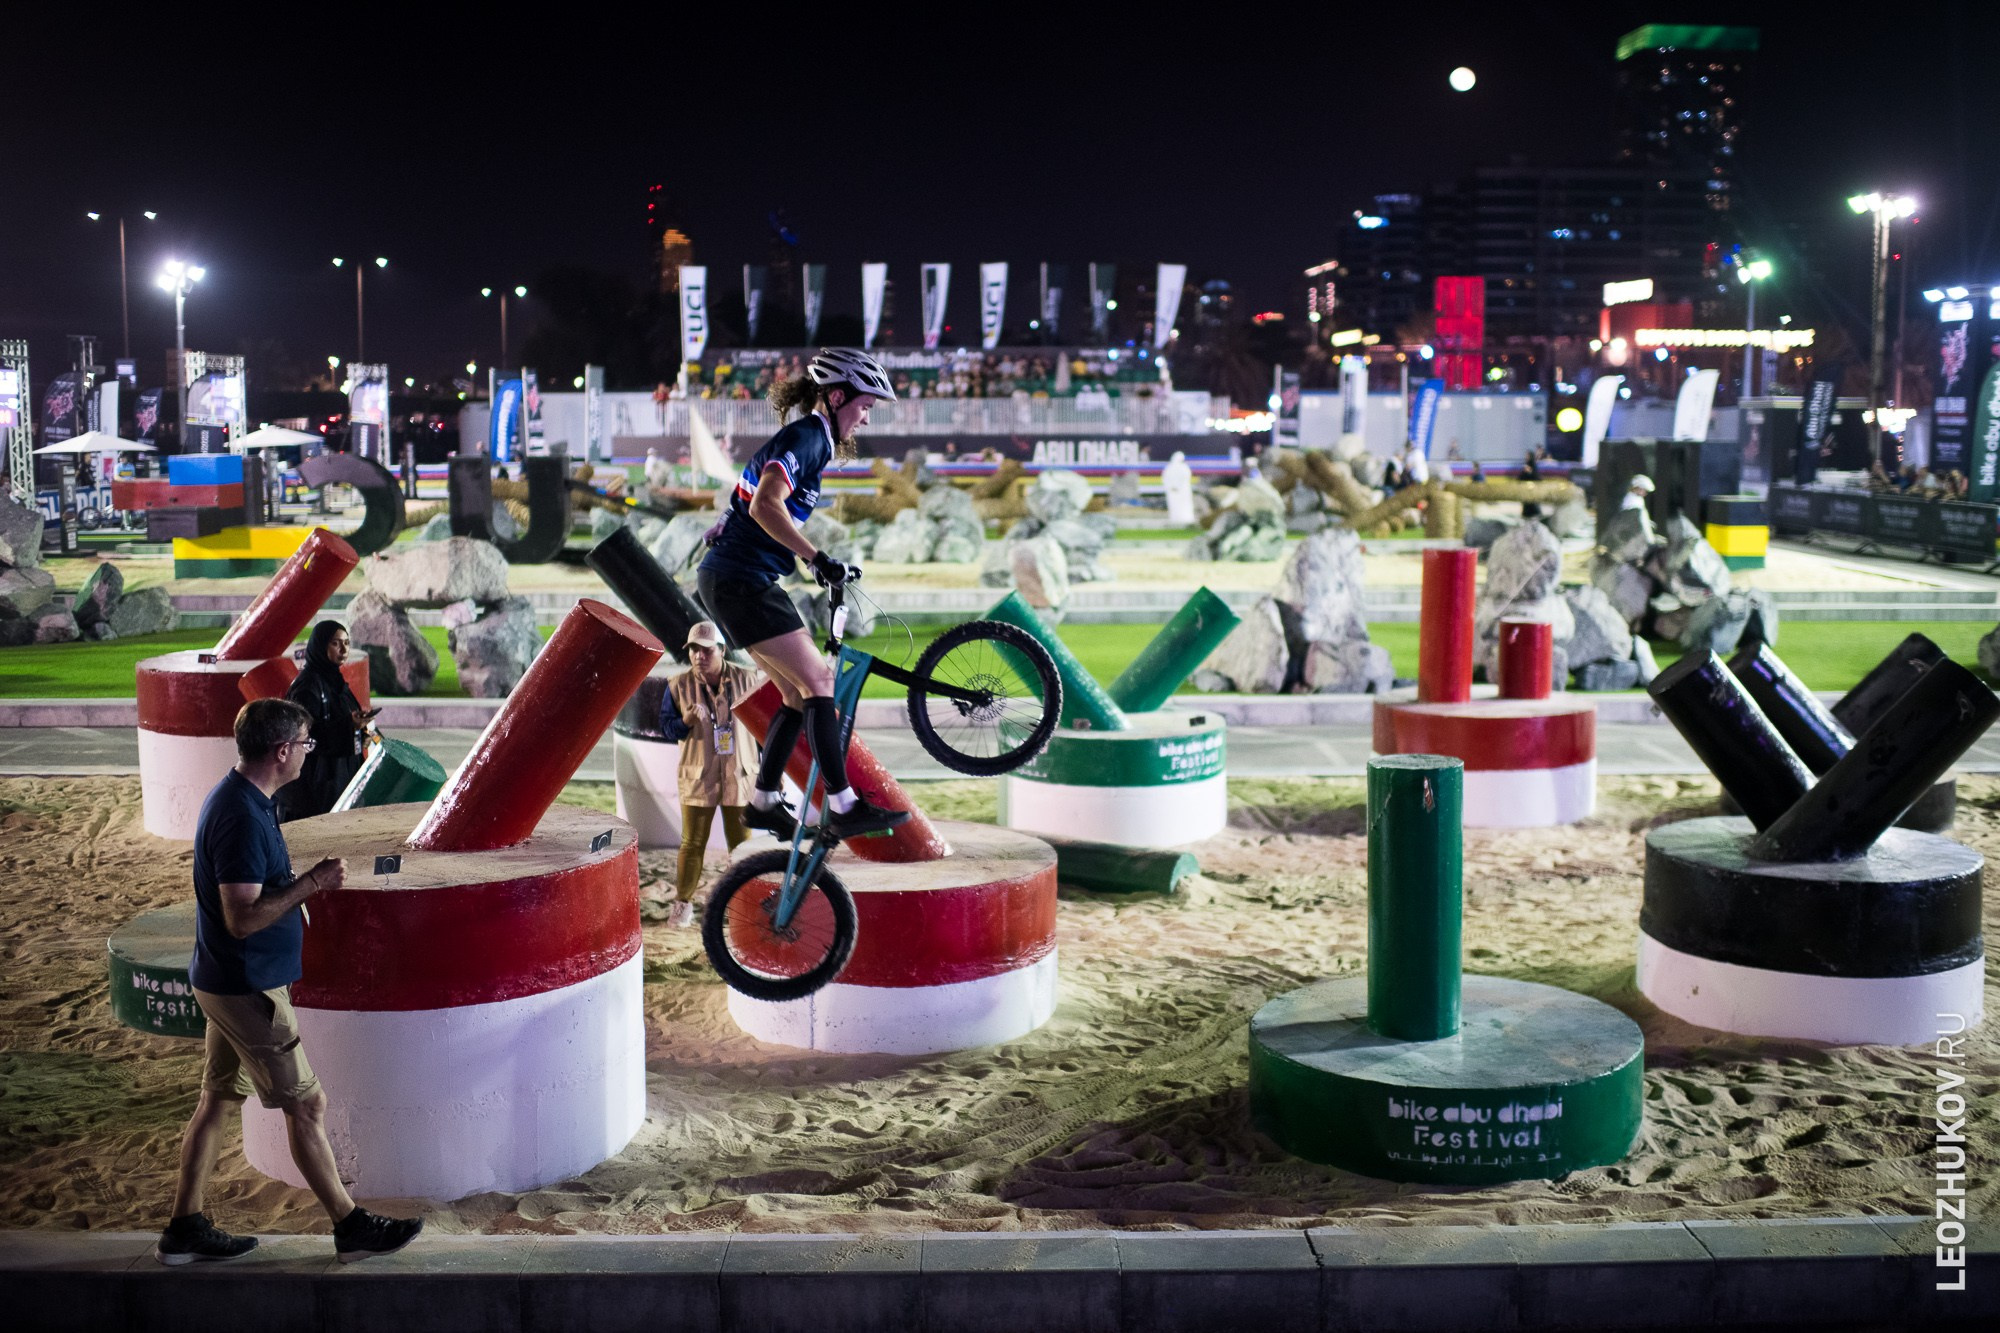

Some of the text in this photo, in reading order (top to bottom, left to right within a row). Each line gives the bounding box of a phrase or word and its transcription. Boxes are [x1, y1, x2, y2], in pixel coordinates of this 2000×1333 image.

[686, 285, 703, 332] UCI
[986, 281, 1002, 328] UCI
[1979, 452, 1997, 485] bike
[133, 971, 194, 997] bike abu
[1388, 1096, 1563, 1124] bike abu dhabi
[1413, 1125, 1542, 1149] Festival
